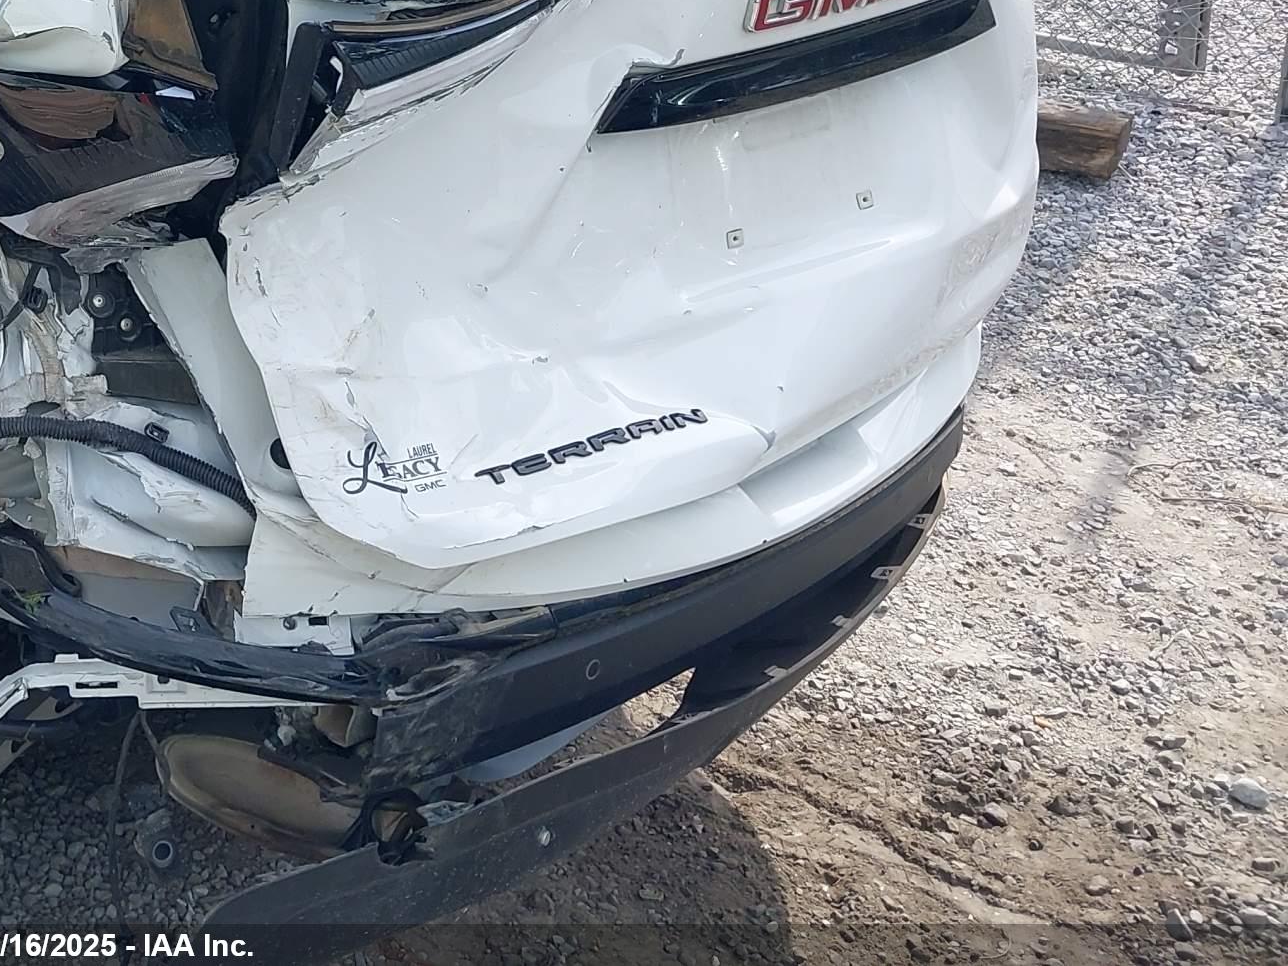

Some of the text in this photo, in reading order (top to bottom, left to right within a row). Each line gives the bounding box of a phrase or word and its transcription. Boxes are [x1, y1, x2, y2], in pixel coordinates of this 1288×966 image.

[407, 442, 438, 459] LAUREL
[473, 407, 710, 486] TERRAIN
[414, 479, 447, 494] GMC
